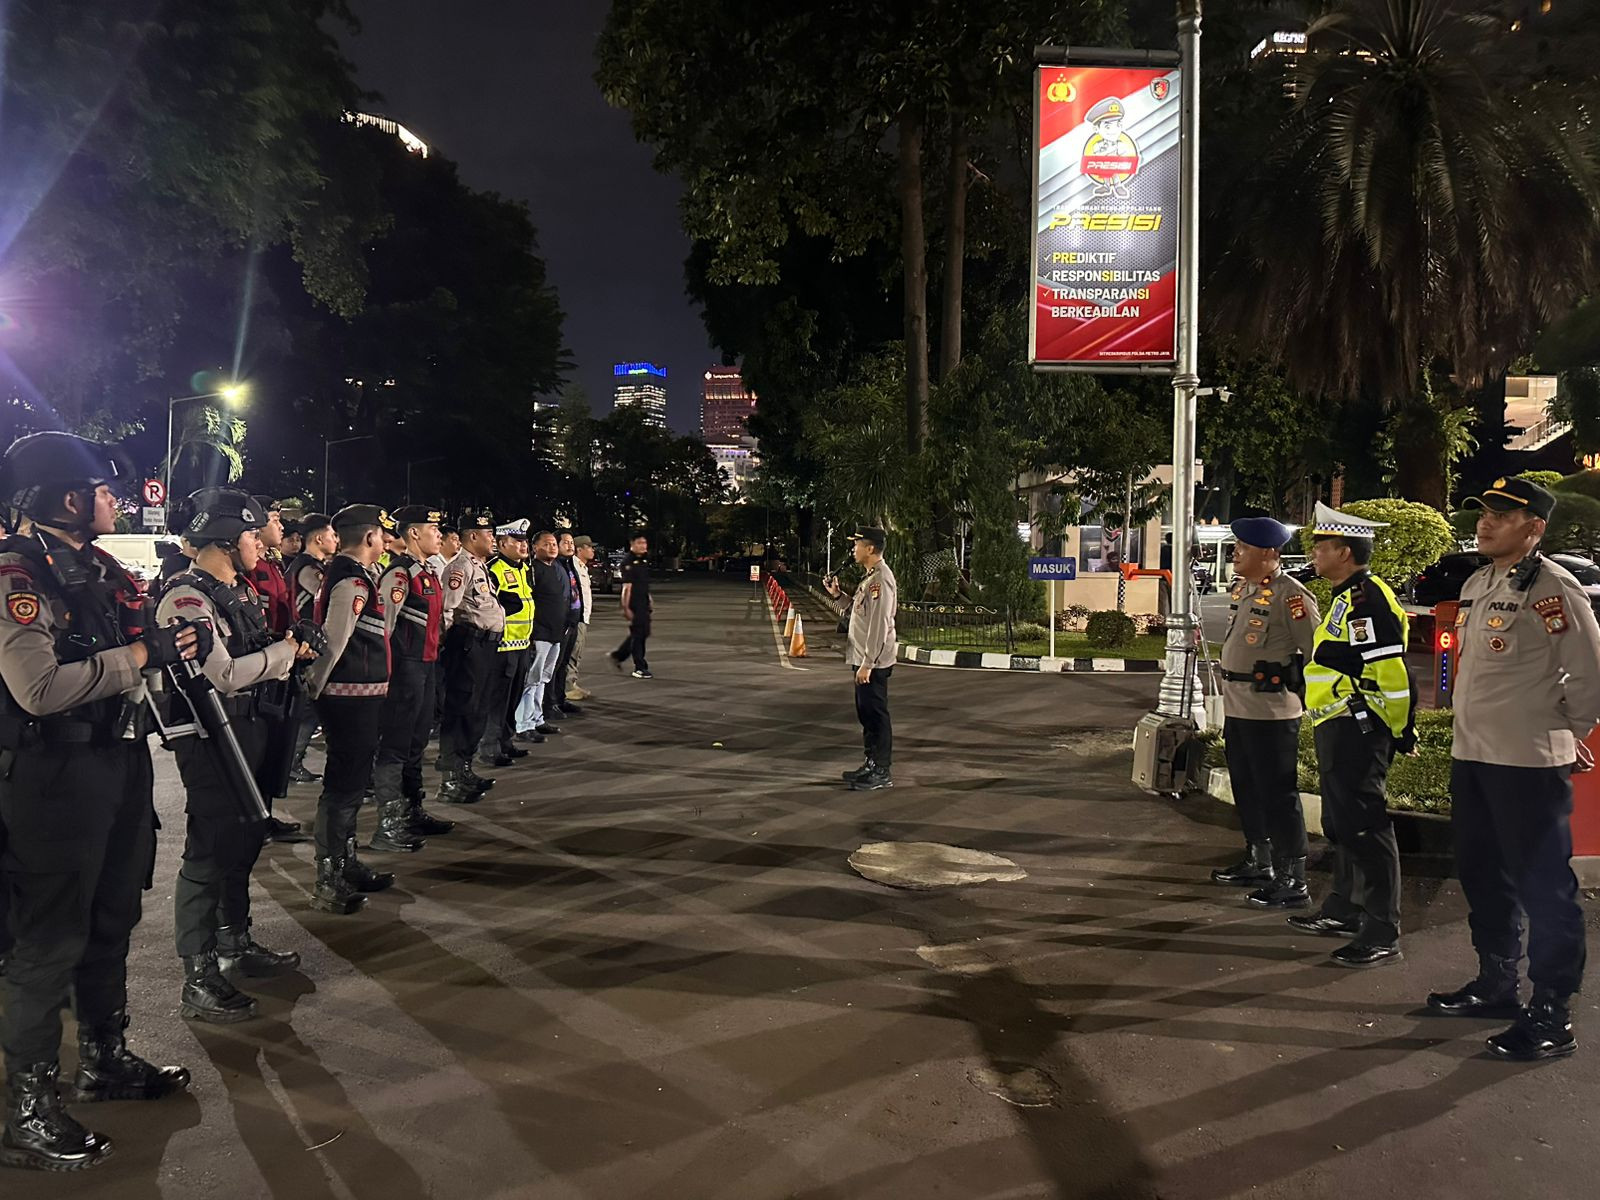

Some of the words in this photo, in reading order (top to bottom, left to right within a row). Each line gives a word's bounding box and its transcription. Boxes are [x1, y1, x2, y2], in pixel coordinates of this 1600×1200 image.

[1049, 213, 1162, 232] PRESISI
[1052, 252, 1117, 264] PREDIKTIF
[1052, 270, 1160, 282] RESPONSIBILITAS
[1052, 288, 1149, 300] TRANSPARANSI
[1051, 306, 1140, 318] BERKEADILAN
[1032, 563, 1071, 574] MASUK
[1488, 601, 1519, 612] POLRI
